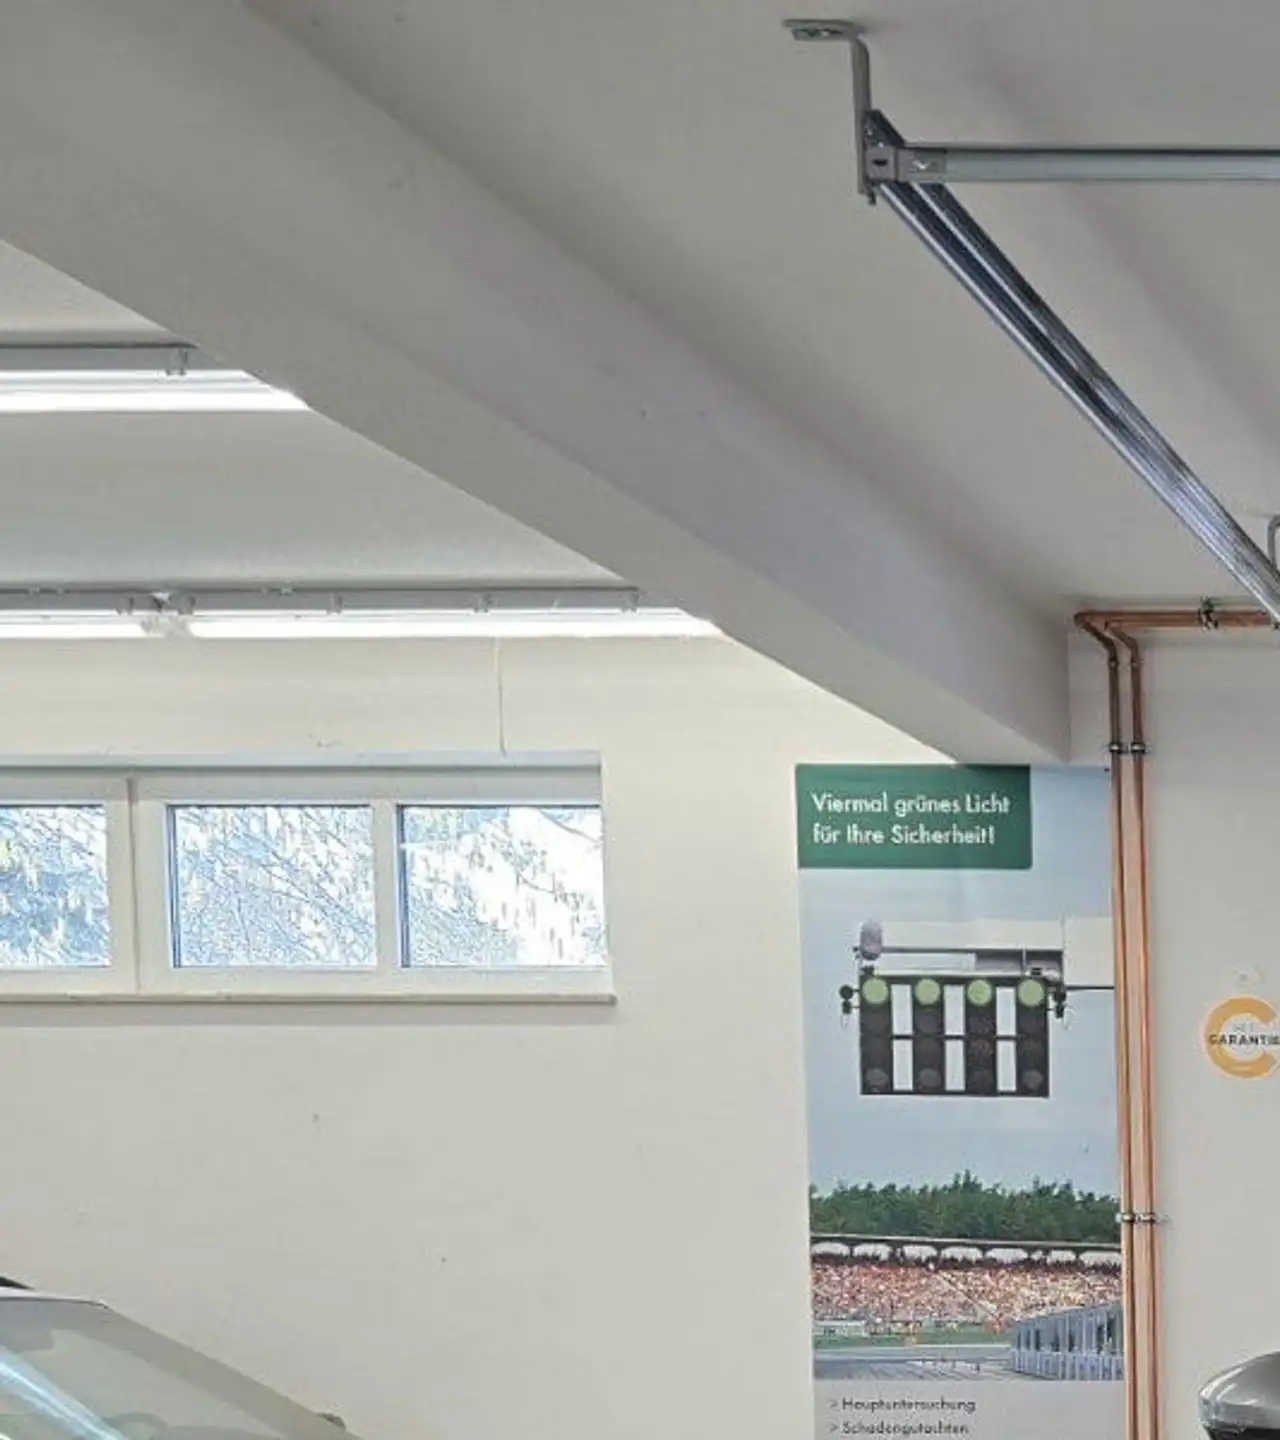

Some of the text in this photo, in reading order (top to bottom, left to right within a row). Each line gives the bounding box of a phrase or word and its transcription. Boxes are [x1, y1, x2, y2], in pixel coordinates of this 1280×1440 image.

[811, 791, 1010, 817] Viermal grünes Licht
[812, 822, 995, 845] für Ihre Sicherheit!
